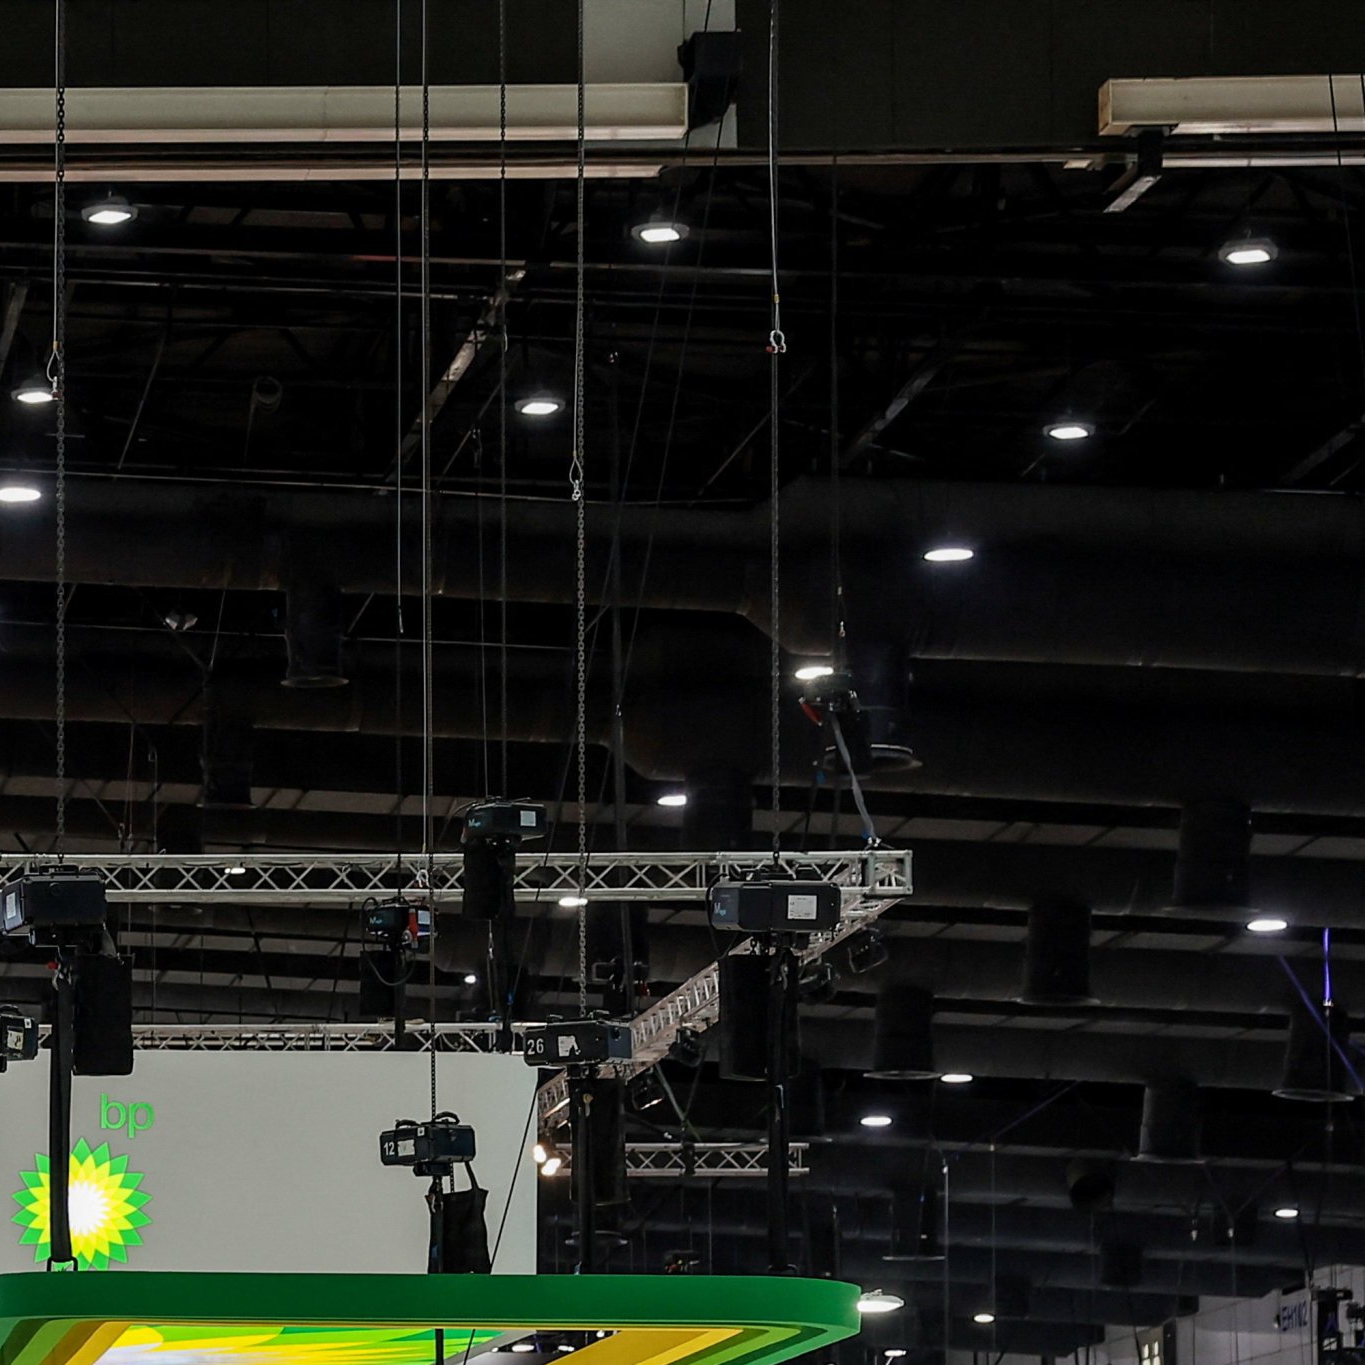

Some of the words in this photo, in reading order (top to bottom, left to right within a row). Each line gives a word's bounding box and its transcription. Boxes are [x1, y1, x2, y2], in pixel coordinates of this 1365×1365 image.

[527, 1038, 544, 1055] 26
[101, 1092, 155, 1138] bp
[383, 1141, 395, 1155] 12
